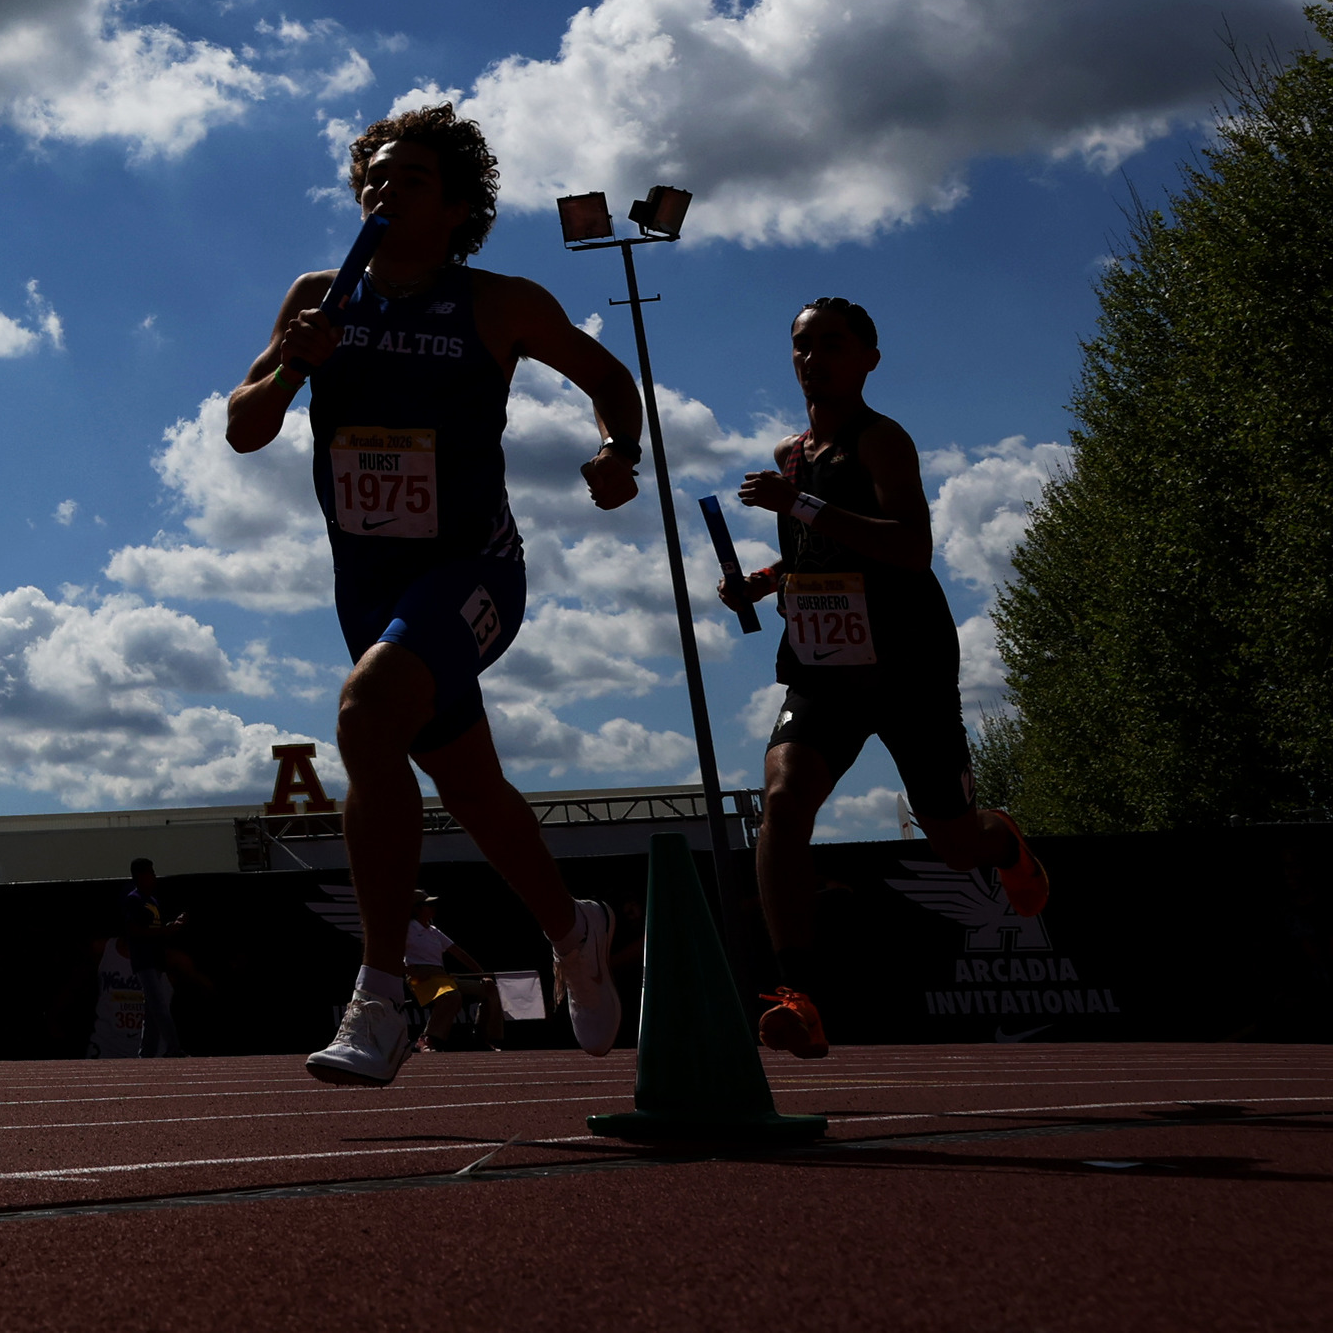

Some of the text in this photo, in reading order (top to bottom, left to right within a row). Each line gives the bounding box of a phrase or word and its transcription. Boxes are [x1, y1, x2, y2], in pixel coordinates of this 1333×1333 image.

[336, 324, 464, 358] OS ALTOS
[349, 435, 413, 449] Arcadia 2026
[359, 453, 401, 471] HURST
[338, 472, 431, 514] 1975
[797, 595, 849, 611] GUERRERO
[471, 599, 498, 646] 13
[792, 612, 866, 645] 1126
[264, 743, 336, 815] A
[955, 958, 1079, 982] ARCADIA
[925, 989, 1122, 1014] INVITATIONAL
